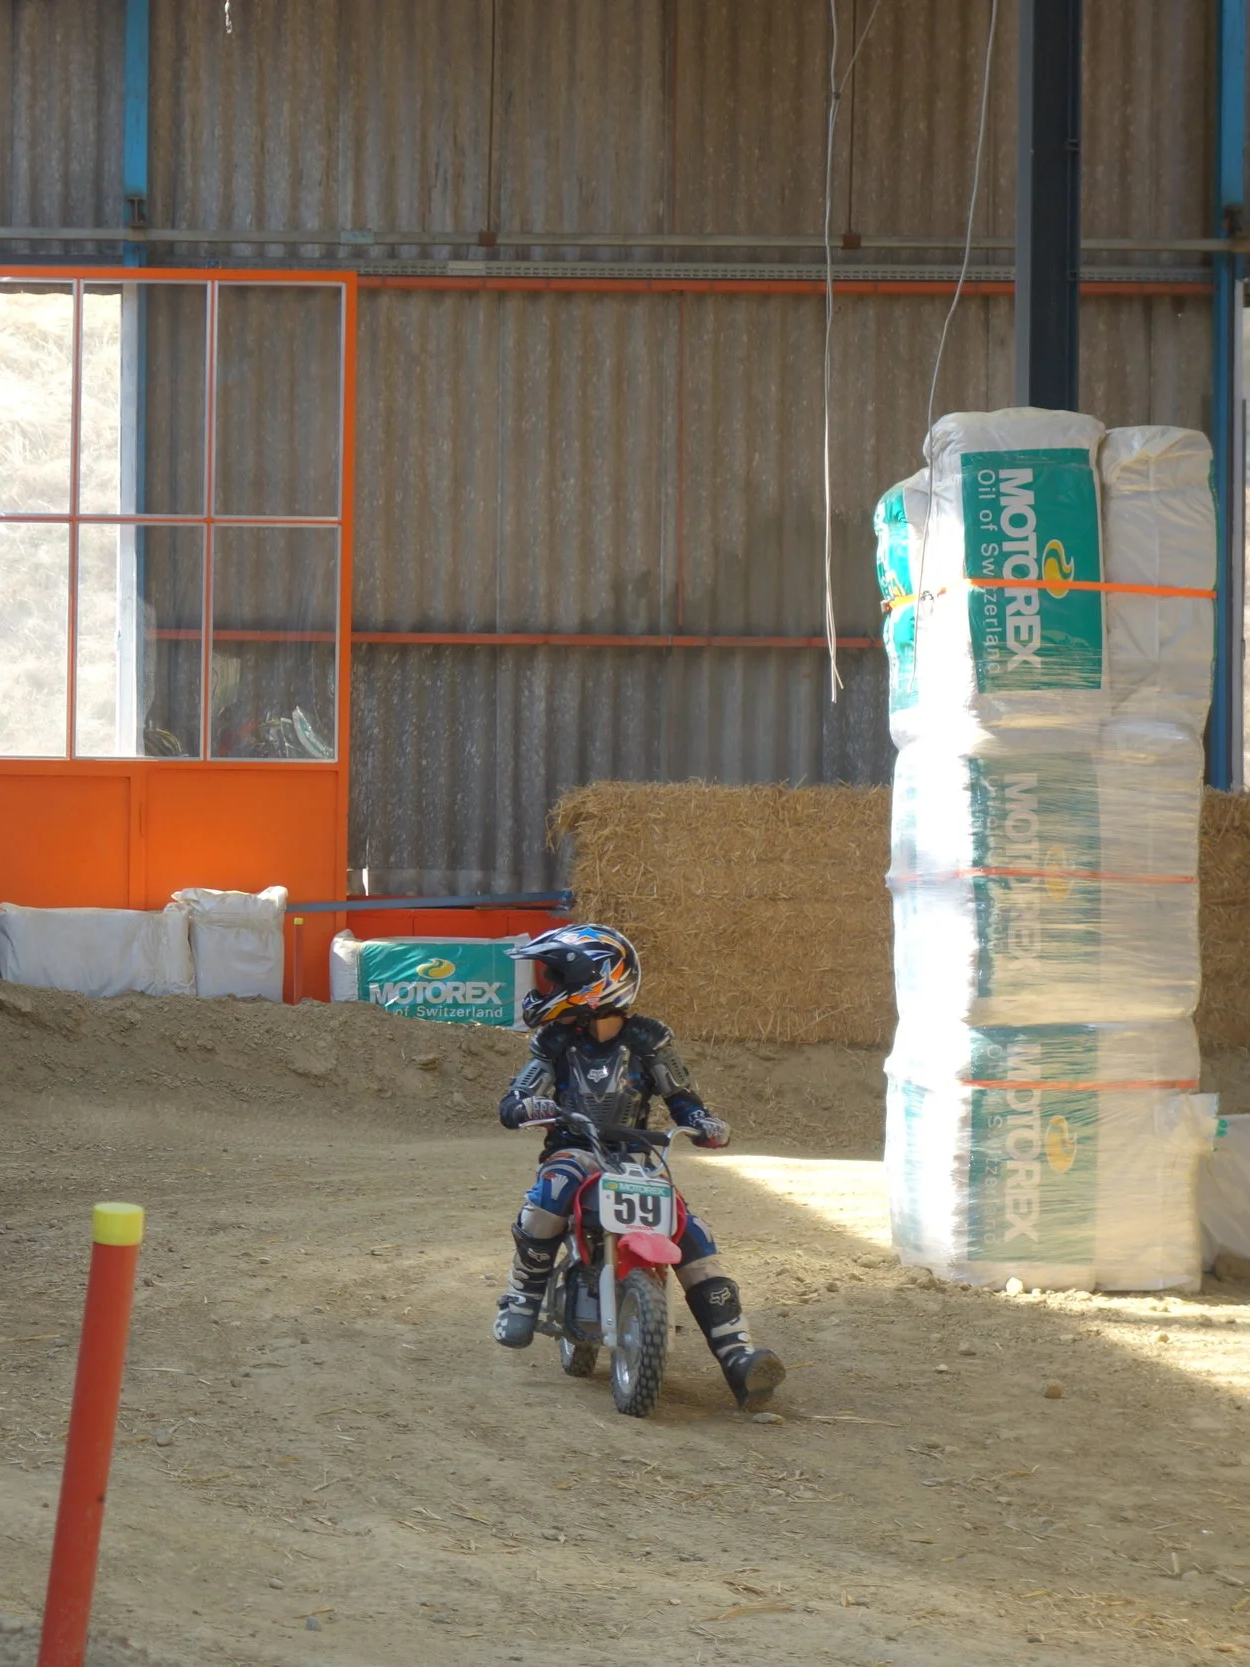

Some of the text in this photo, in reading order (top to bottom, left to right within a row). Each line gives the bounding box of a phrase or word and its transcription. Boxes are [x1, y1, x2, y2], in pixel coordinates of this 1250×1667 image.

[977, 469, 1003, 674] Oil of Swtzerland
[998, 468, 1042, 673] MOTOREX
[369, 981, 502, 1005] MOTOREX
[416, 1006, 503, 1018] Switzerland
[1005, 1042, 1042, 1244] MOTOREX
[614, 1191, 661, 1227] 59
